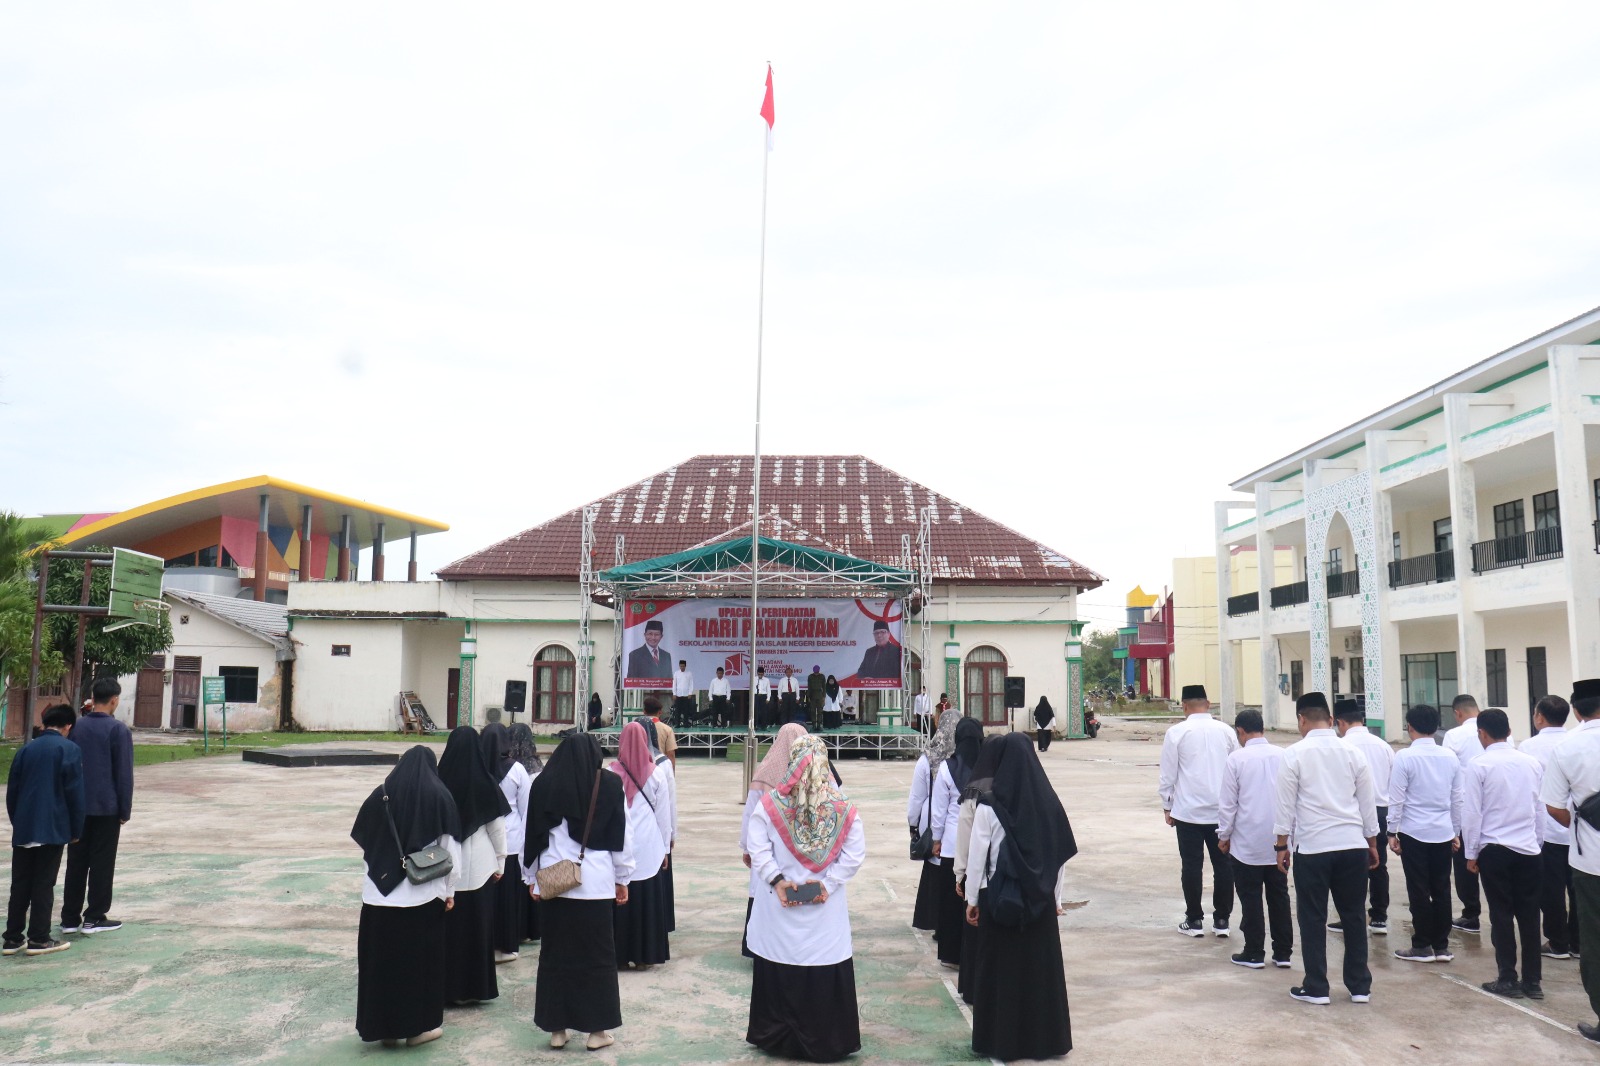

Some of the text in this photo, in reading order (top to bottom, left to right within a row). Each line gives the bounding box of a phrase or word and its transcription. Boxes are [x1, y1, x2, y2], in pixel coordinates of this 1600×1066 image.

[761, 607, 816, 618] PERINGATAN
[695, 617, 840, 638] HARI PAHLAWAN
